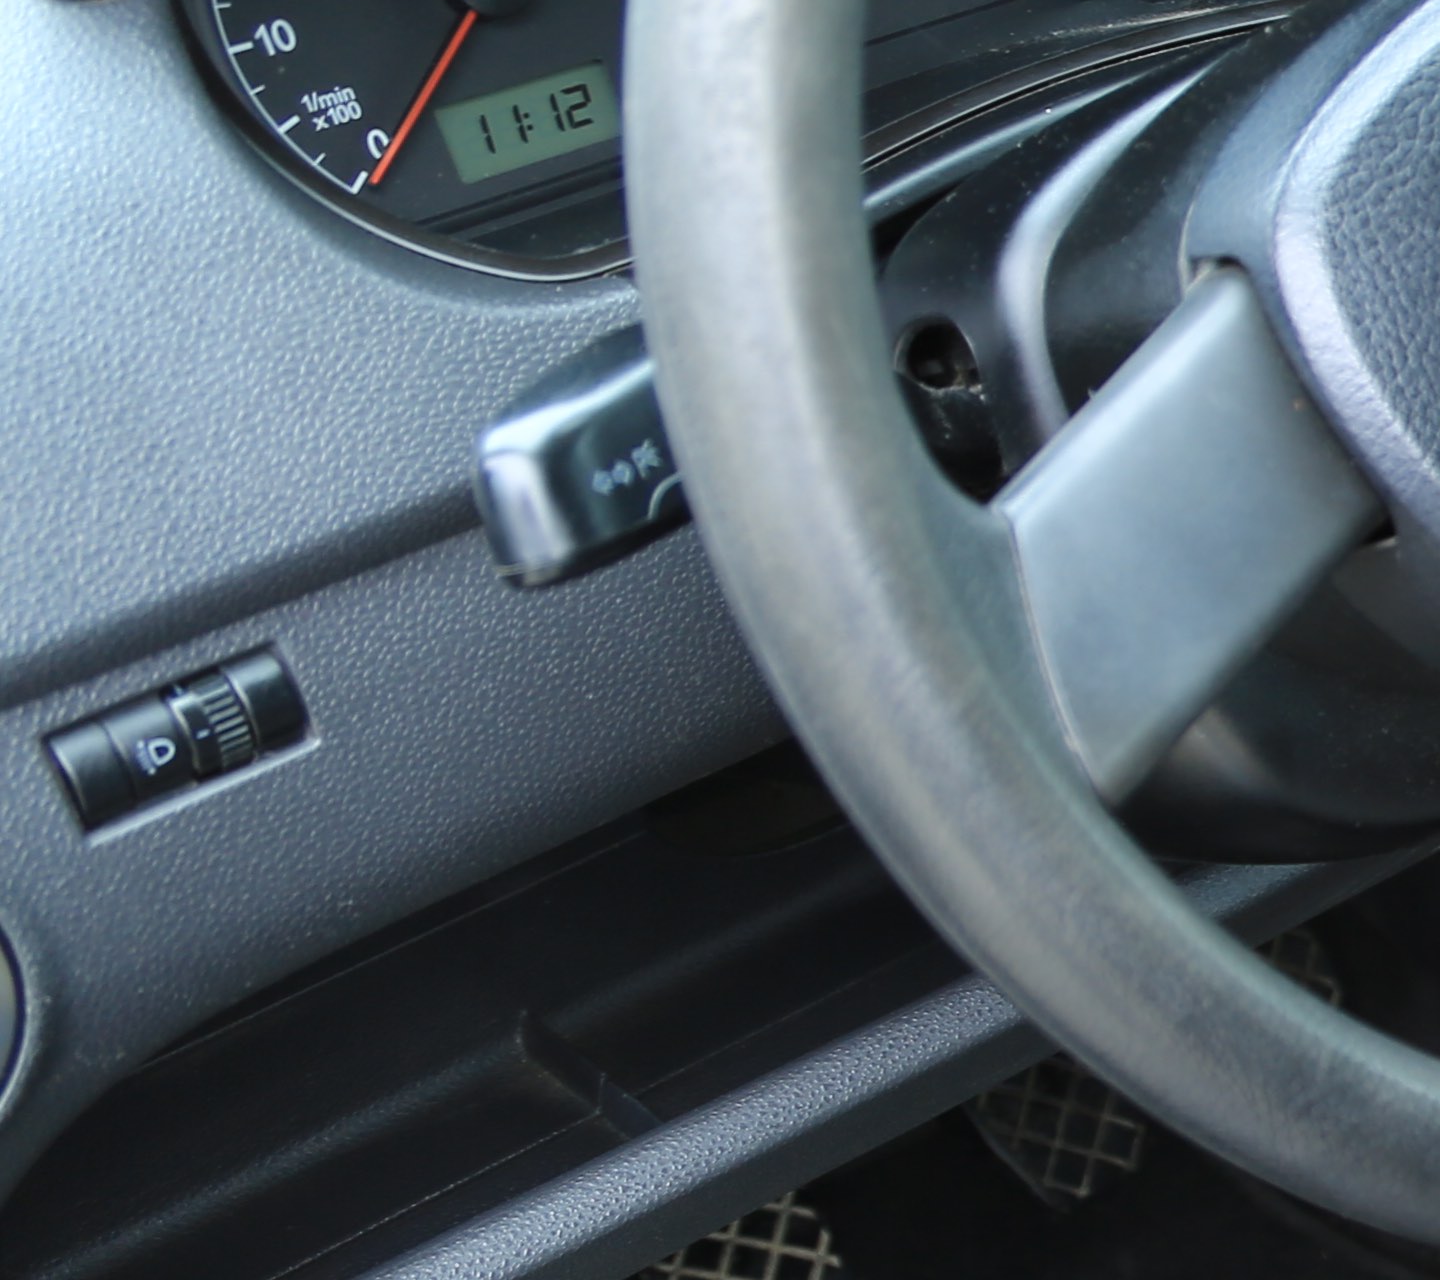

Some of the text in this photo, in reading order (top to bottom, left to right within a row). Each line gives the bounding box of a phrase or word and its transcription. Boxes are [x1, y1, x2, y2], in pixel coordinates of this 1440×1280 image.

[254, 18, 297, 56] 10
[301, 85, 356, 113] 1/min
[312, 101, 362, 131] x100
[479, 83, 594, 154] 11:12
[365, 128, 390, 159] 0
